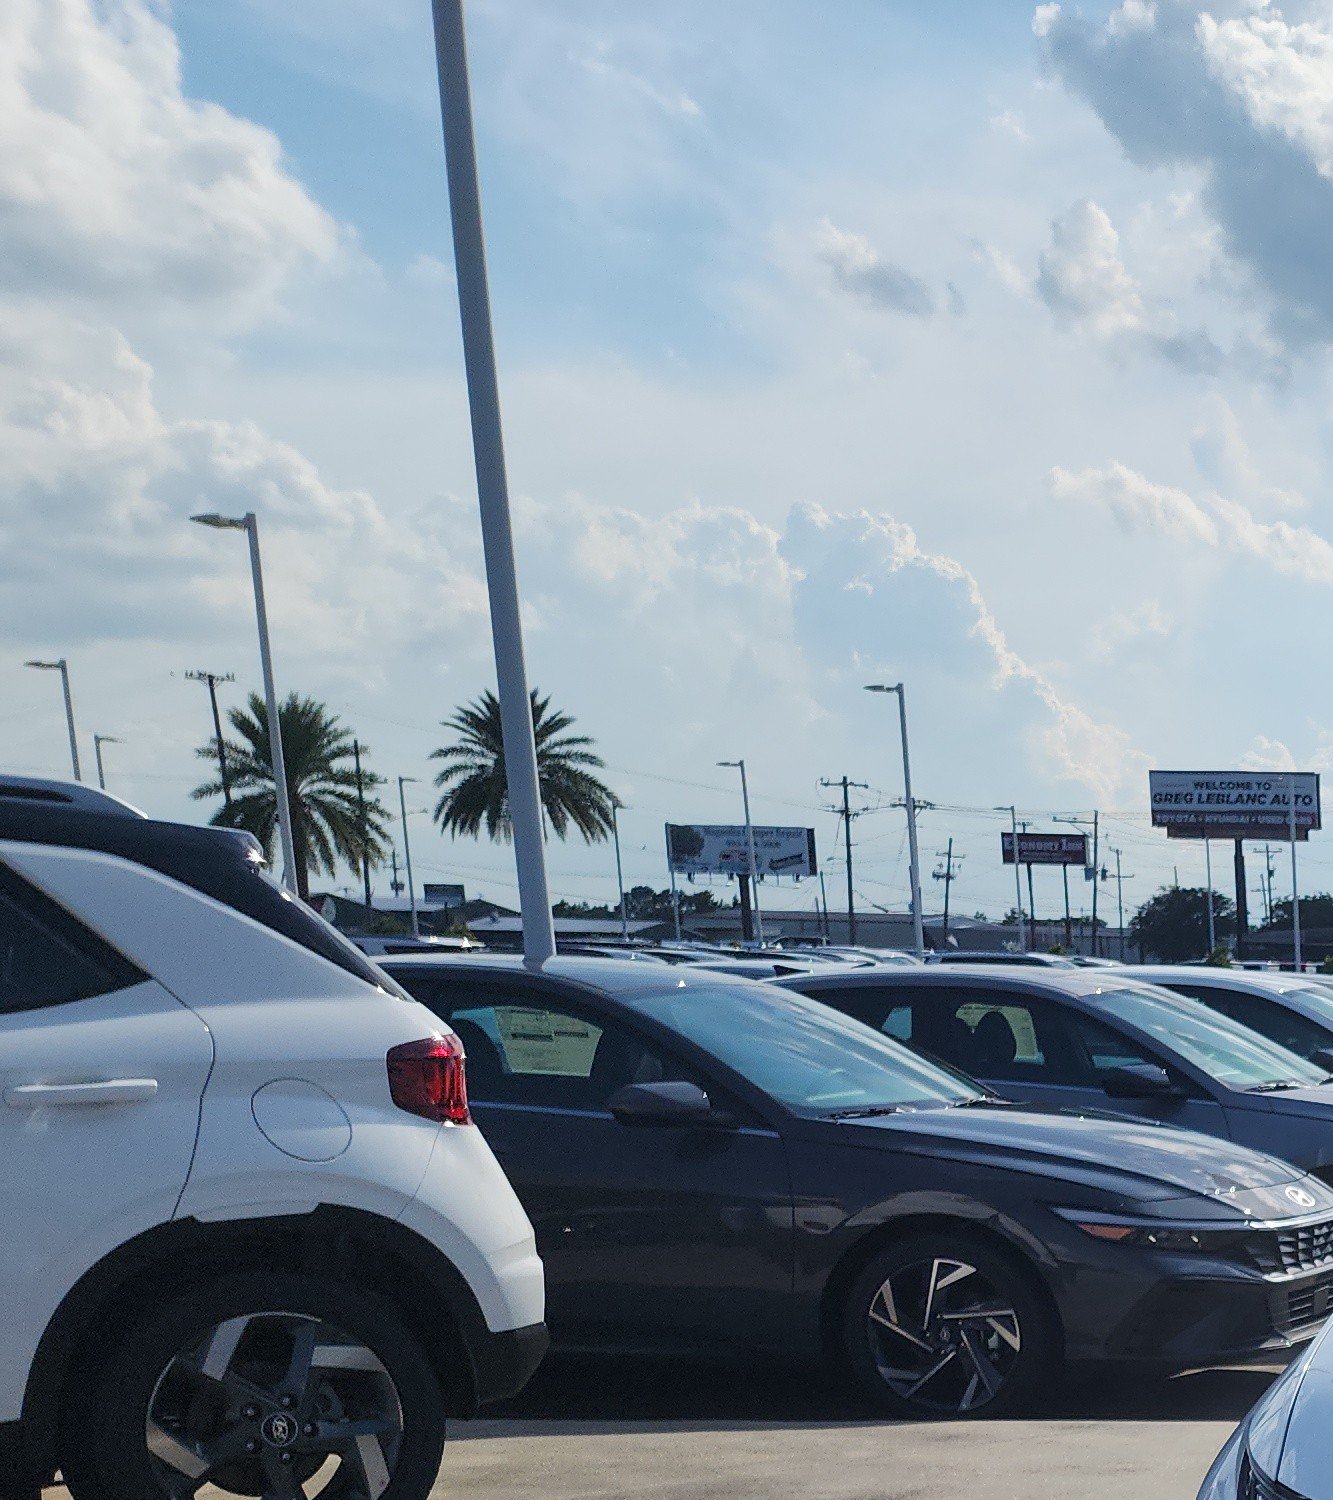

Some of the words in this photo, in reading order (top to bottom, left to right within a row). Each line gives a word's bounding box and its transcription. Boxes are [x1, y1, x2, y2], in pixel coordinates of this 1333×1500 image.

[1193, 781, 1252, 791] WELCOME
[1256, 781, 1272, 791] TO
[1153, 792, 1194, 805] GREG
[1197, 793, 1268, 806] LEBLANC
[1269, 793, 1313, 806] AUTO
